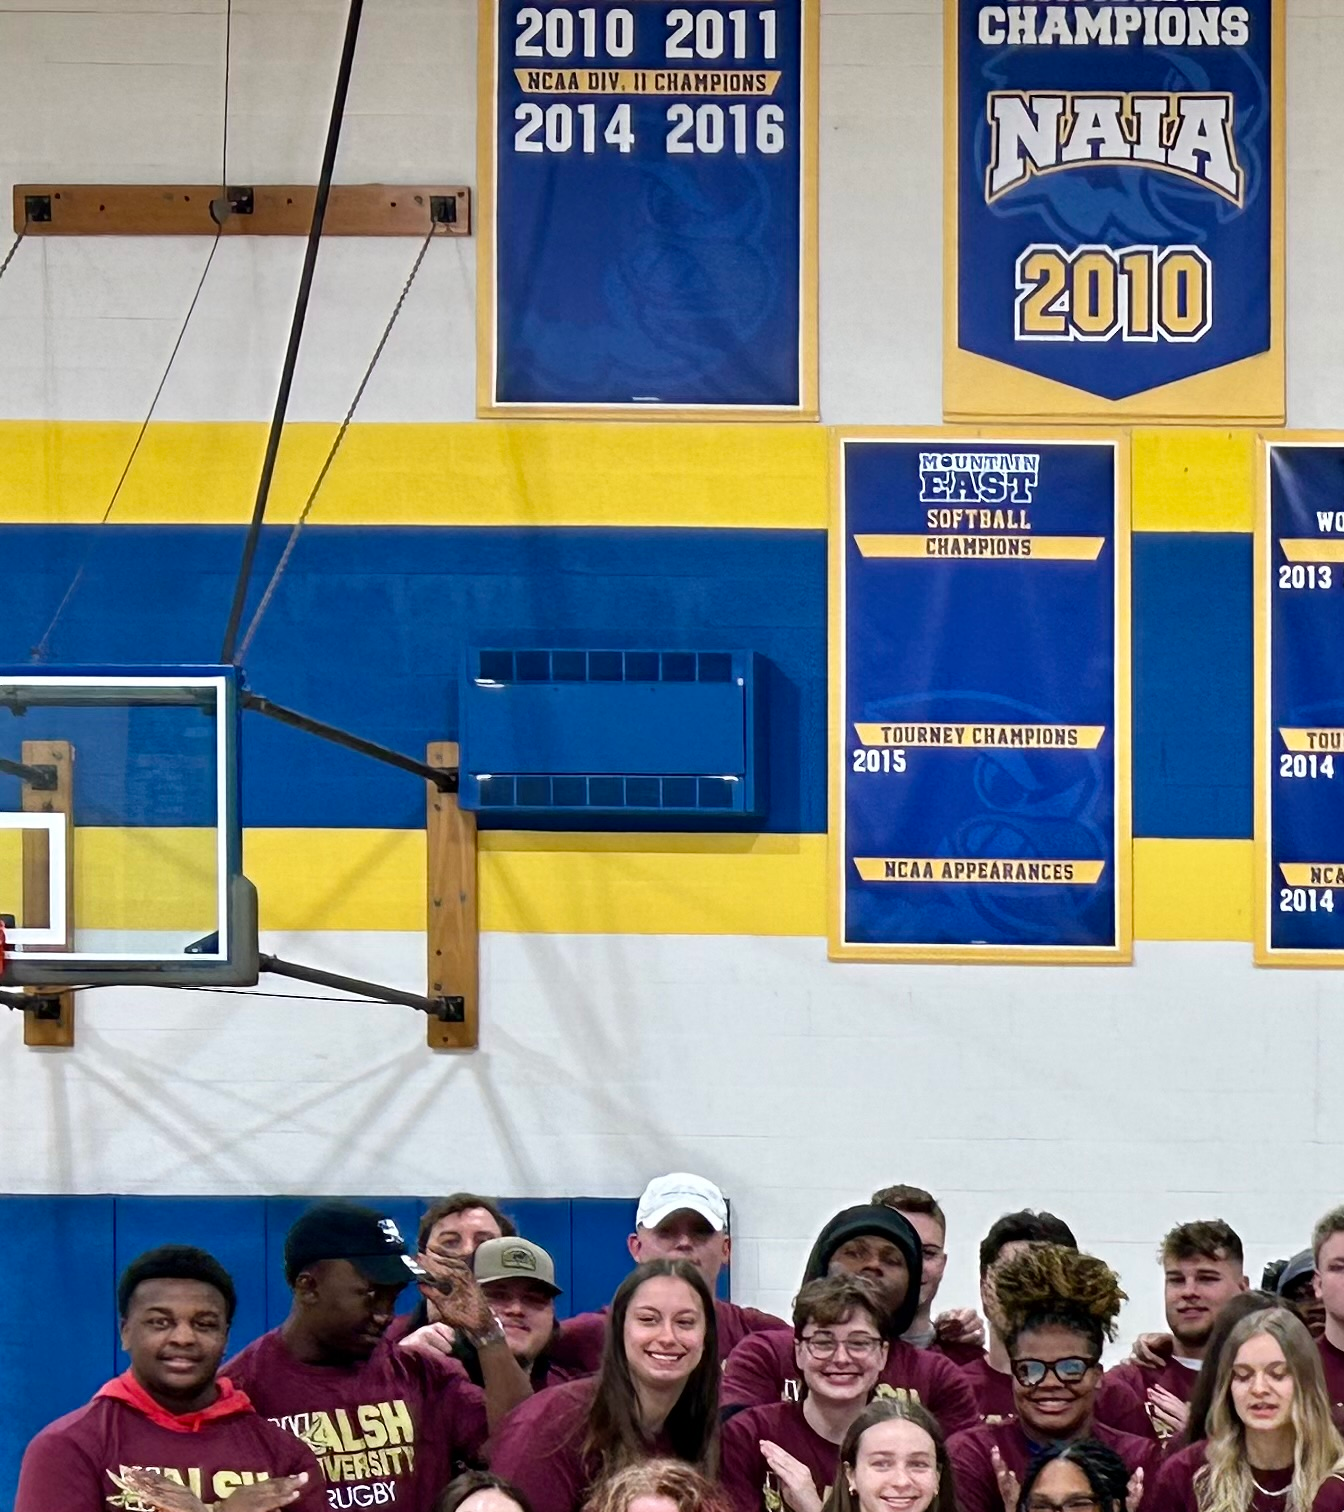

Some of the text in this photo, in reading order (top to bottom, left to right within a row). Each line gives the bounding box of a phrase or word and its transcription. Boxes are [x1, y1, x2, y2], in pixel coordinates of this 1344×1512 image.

[515, 8, 777, 58] 2010 2011
[978, 7, 1248, 47] CHAMPIONS
[528, 72, 766, 93] NCAA DIV. II CHAMPIONS
[515, 103, 783, 153] 2014 2016
[986, 91, 1243, 206] NAIA
[1014, 243, 1212, 343] 2010
[919, 452, 1040, 476] MOUNTAIN
[919, 474, 1038, 504] EAST
[927, 510, 1030, 530] SOFTBALL
[925, 538, 1031, 557] CHAMPIONS
[1279, 566, 1331, 590] 2013
[881, 726, 1078, 746] TOURNEY CHAMPIONS
[853, 750, 906, 774] 2015
[1280, 756, 1334, 780] 2014
[884, 861, 1073, 881] NCAA APPEARANCES
[1280, 890, 1334, 914] 2014
